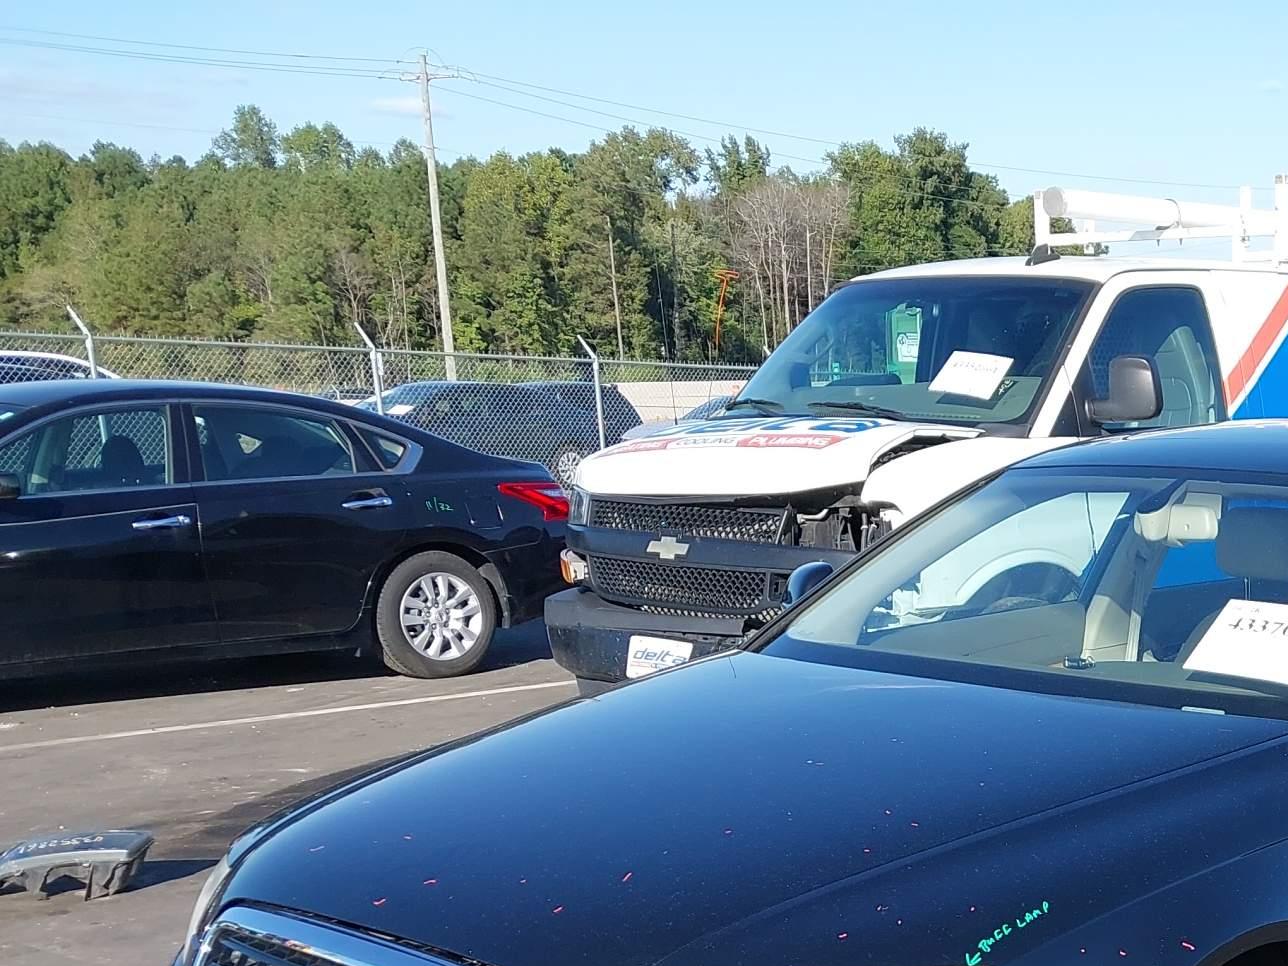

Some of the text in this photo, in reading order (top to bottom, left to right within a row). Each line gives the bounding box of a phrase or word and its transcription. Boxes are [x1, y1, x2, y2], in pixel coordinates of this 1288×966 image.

[747, 435, 831, 447] PLUMBING
[633, 648, 687, 663] delta
[1016, 900, 1049, 928] LAMP
